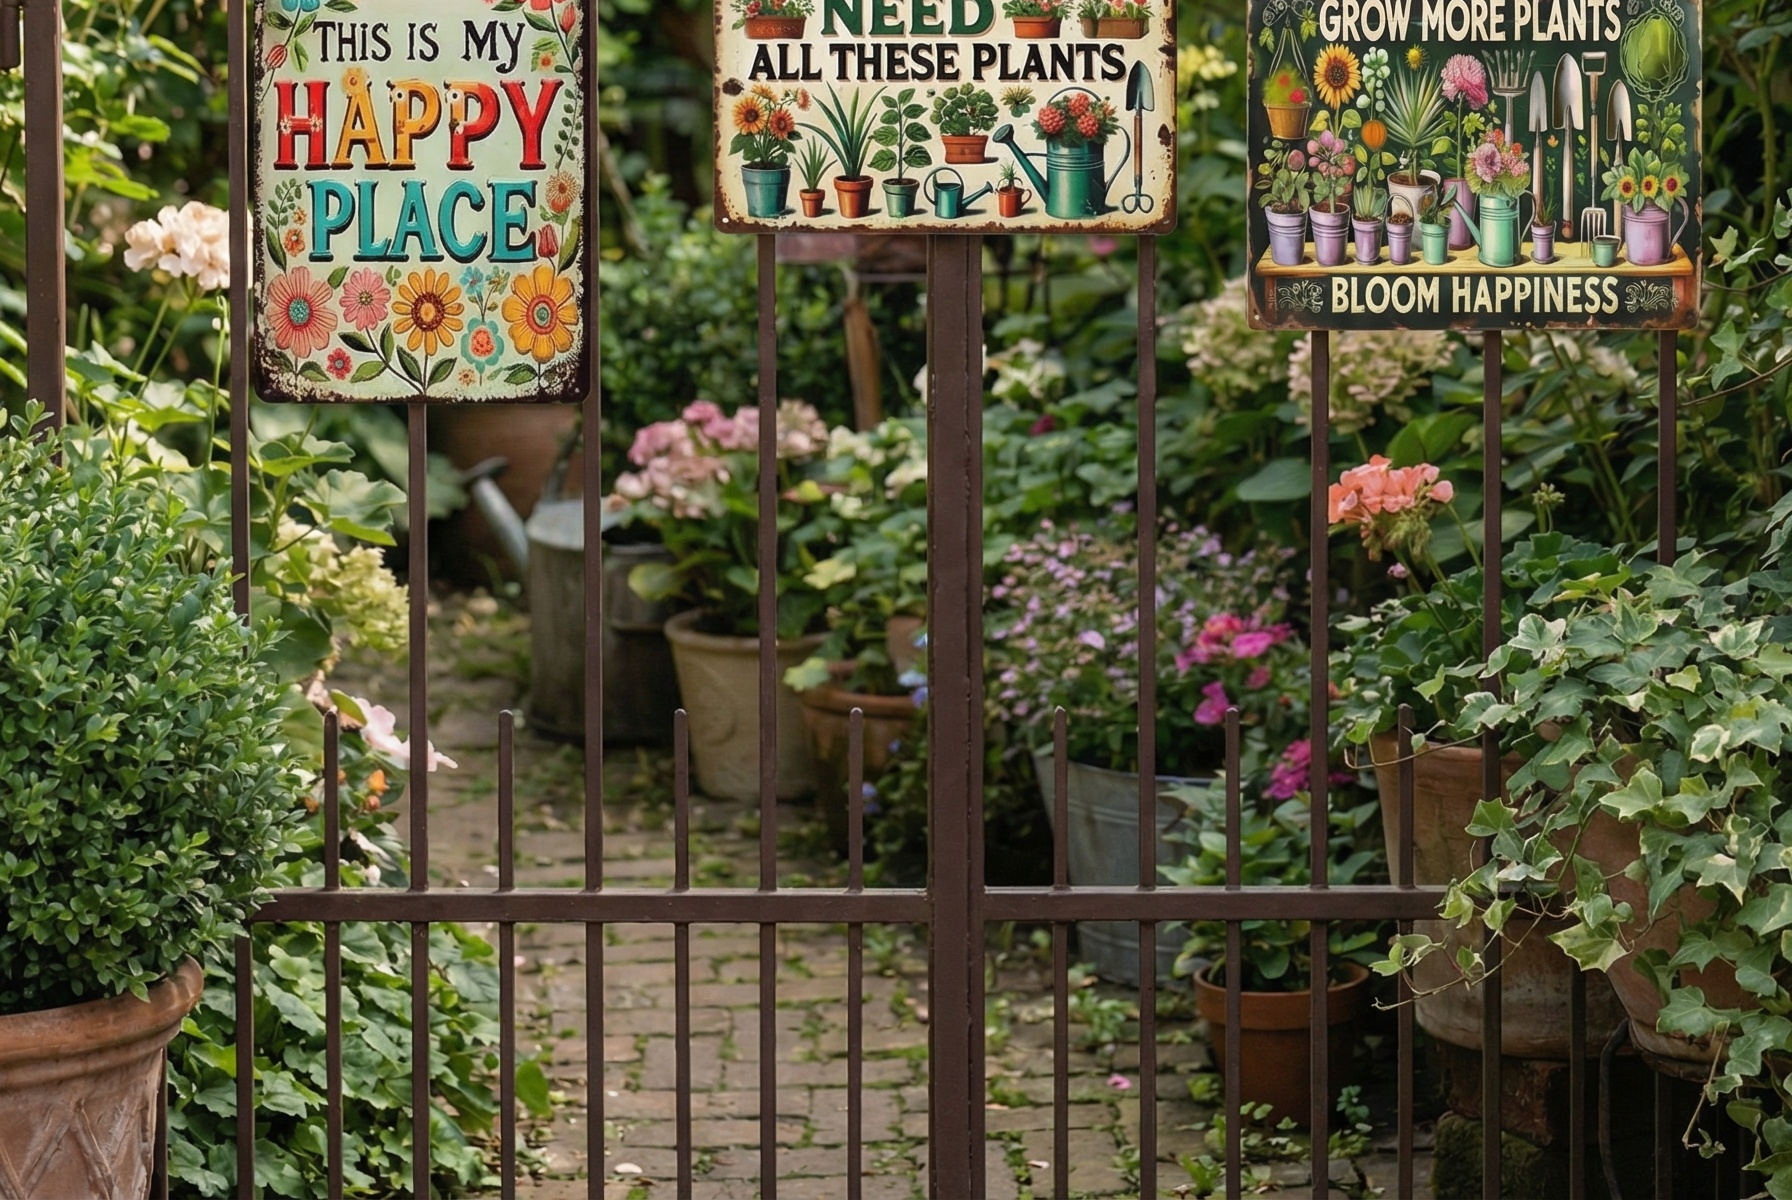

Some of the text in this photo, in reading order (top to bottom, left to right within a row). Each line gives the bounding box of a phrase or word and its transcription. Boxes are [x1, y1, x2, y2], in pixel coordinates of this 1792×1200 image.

[406, 21, 439, 62] IS
[748, 42, 1127, 82] ALL THESE PLANTS
[273, 78, 565, 171] HAPPY
[306, 178, 540, 263] PLACE
[1330, 275, 1620, 314] BLOOM HAPPINESS
